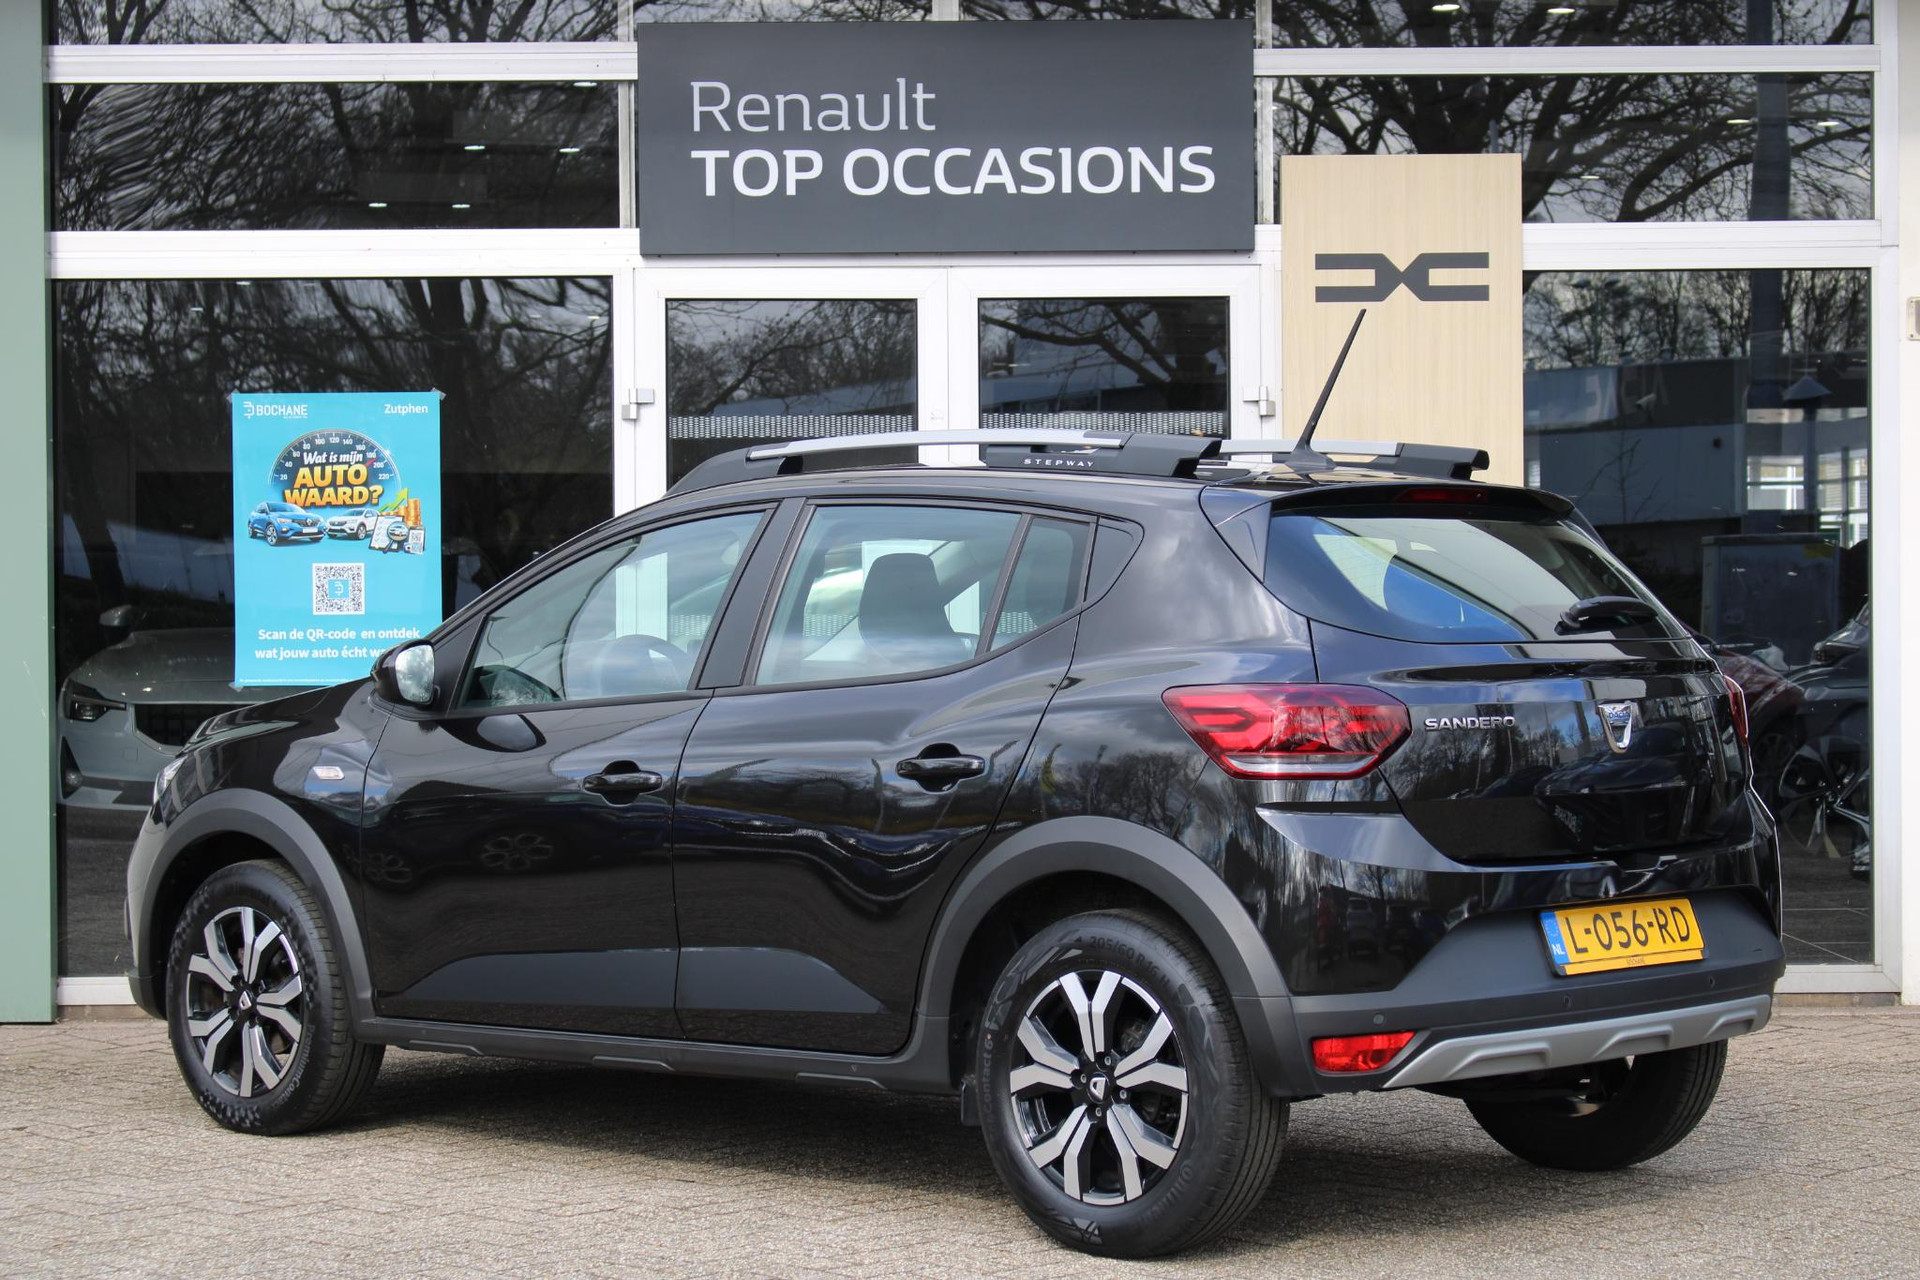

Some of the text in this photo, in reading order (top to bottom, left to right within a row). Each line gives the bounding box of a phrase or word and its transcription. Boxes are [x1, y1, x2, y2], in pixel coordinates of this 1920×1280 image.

[691, 77, 936, 133] Renault
[691, 145, 1215, 197] TOP OCCASIONS
[256, 404, 308, 416] BOCHANE
[384, 404, 428, 416] Zutphen
[285, 460, 293, 468] 40
[303, 451, 363, 465] Wat is mijn
[1024, 458, 1094, 467] STEPWAY
[294, 465, 367, 487] AUTO
[284, 486, 383, 506] WAARD?
[258, 627, 420, 641] Scan de QR-code en ontdek
[255, 648, 277, 659] wat
[279, 647, 309, 661] jouw
[311, 647, 338, 658] auto
[341, 646, 368, 659] écht
[1424, 715, 1516, 731] SANDERO
[1553, 907, 1690, 955] NL L-056-RD
[1089, 935, 1136, 961] 205/60
[983, 1038, 994, 1050] 6
[271, 1023, 316, 1110] PremiumContac
